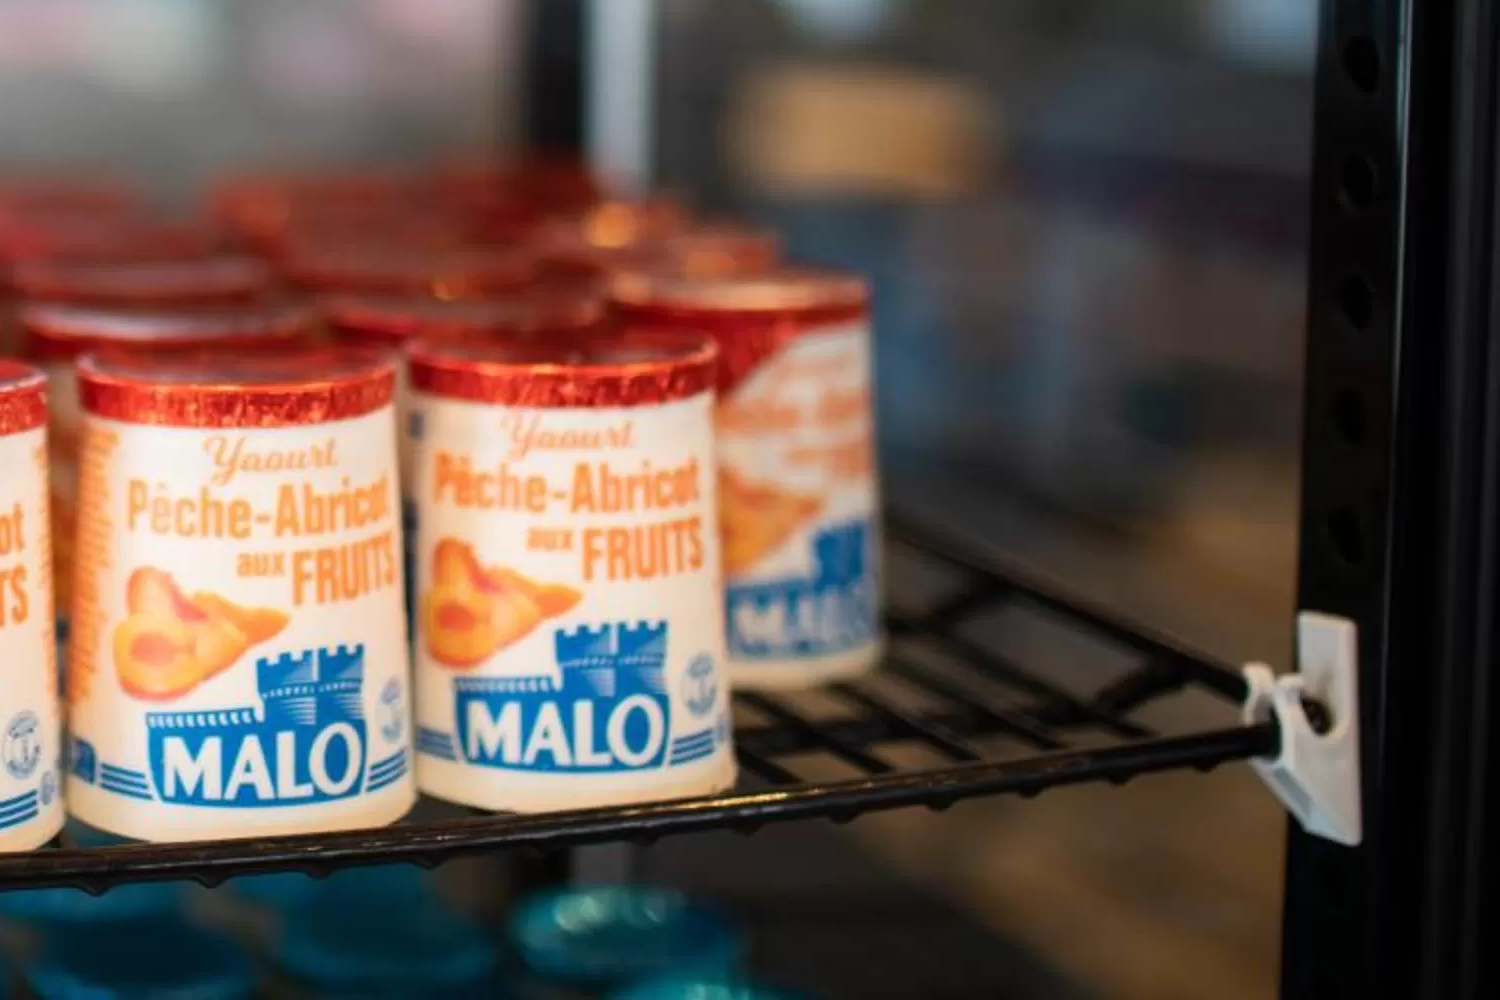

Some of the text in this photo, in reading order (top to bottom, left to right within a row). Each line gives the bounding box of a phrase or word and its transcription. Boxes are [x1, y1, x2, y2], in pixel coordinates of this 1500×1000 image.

[203, 436, 338, 486] Yaourt
[128, 477, 389, 539] Pêche-Abricot
[237, 532, 394, 607] aux FRUITS
[583, 516, 703, 582] FRUITS
[163, 721, 361, 800] MALO
[468, 695, 664, 767] MALO
